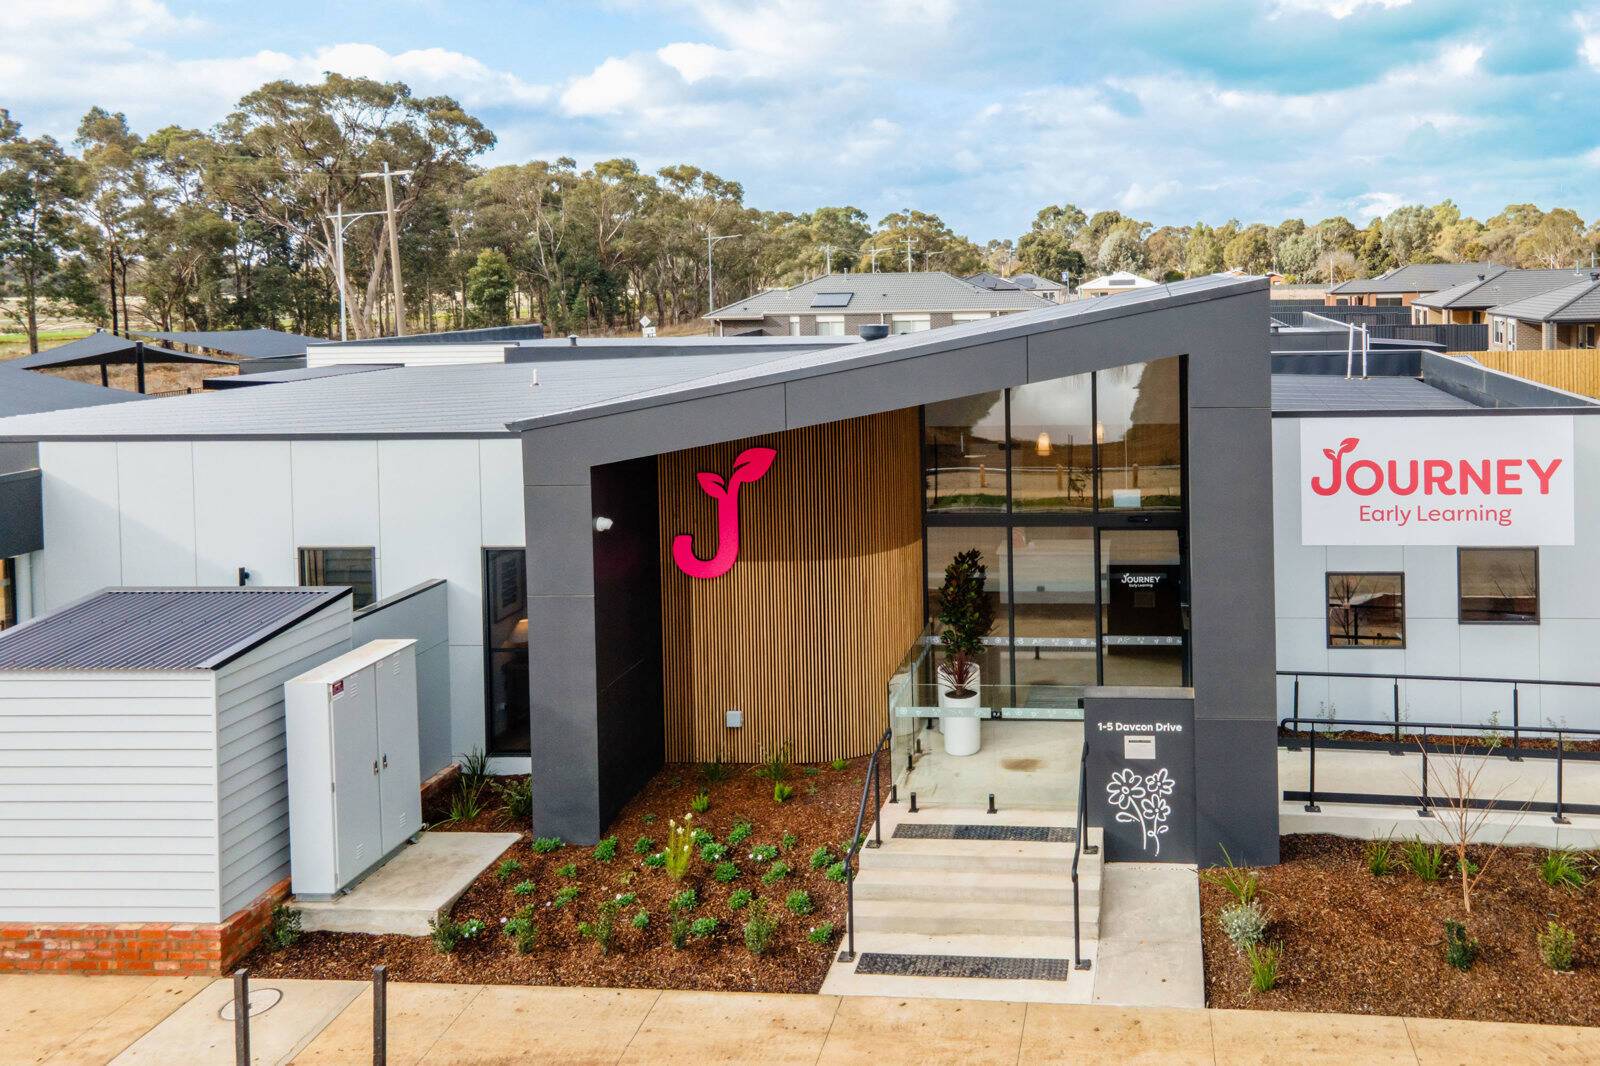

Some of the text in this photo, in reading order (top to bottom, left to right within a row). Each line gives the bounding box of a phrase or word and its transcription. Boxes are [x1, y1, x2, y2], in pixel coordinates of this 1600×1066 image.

[1310, 437, 1563, 496] JOURNEY
[1359, 504, 1512, 527] Early Learning
[1121, 573, 1160, 584] JOURNEY
[1097, 722, 1182, 732] 1-5 Davcon Drive
